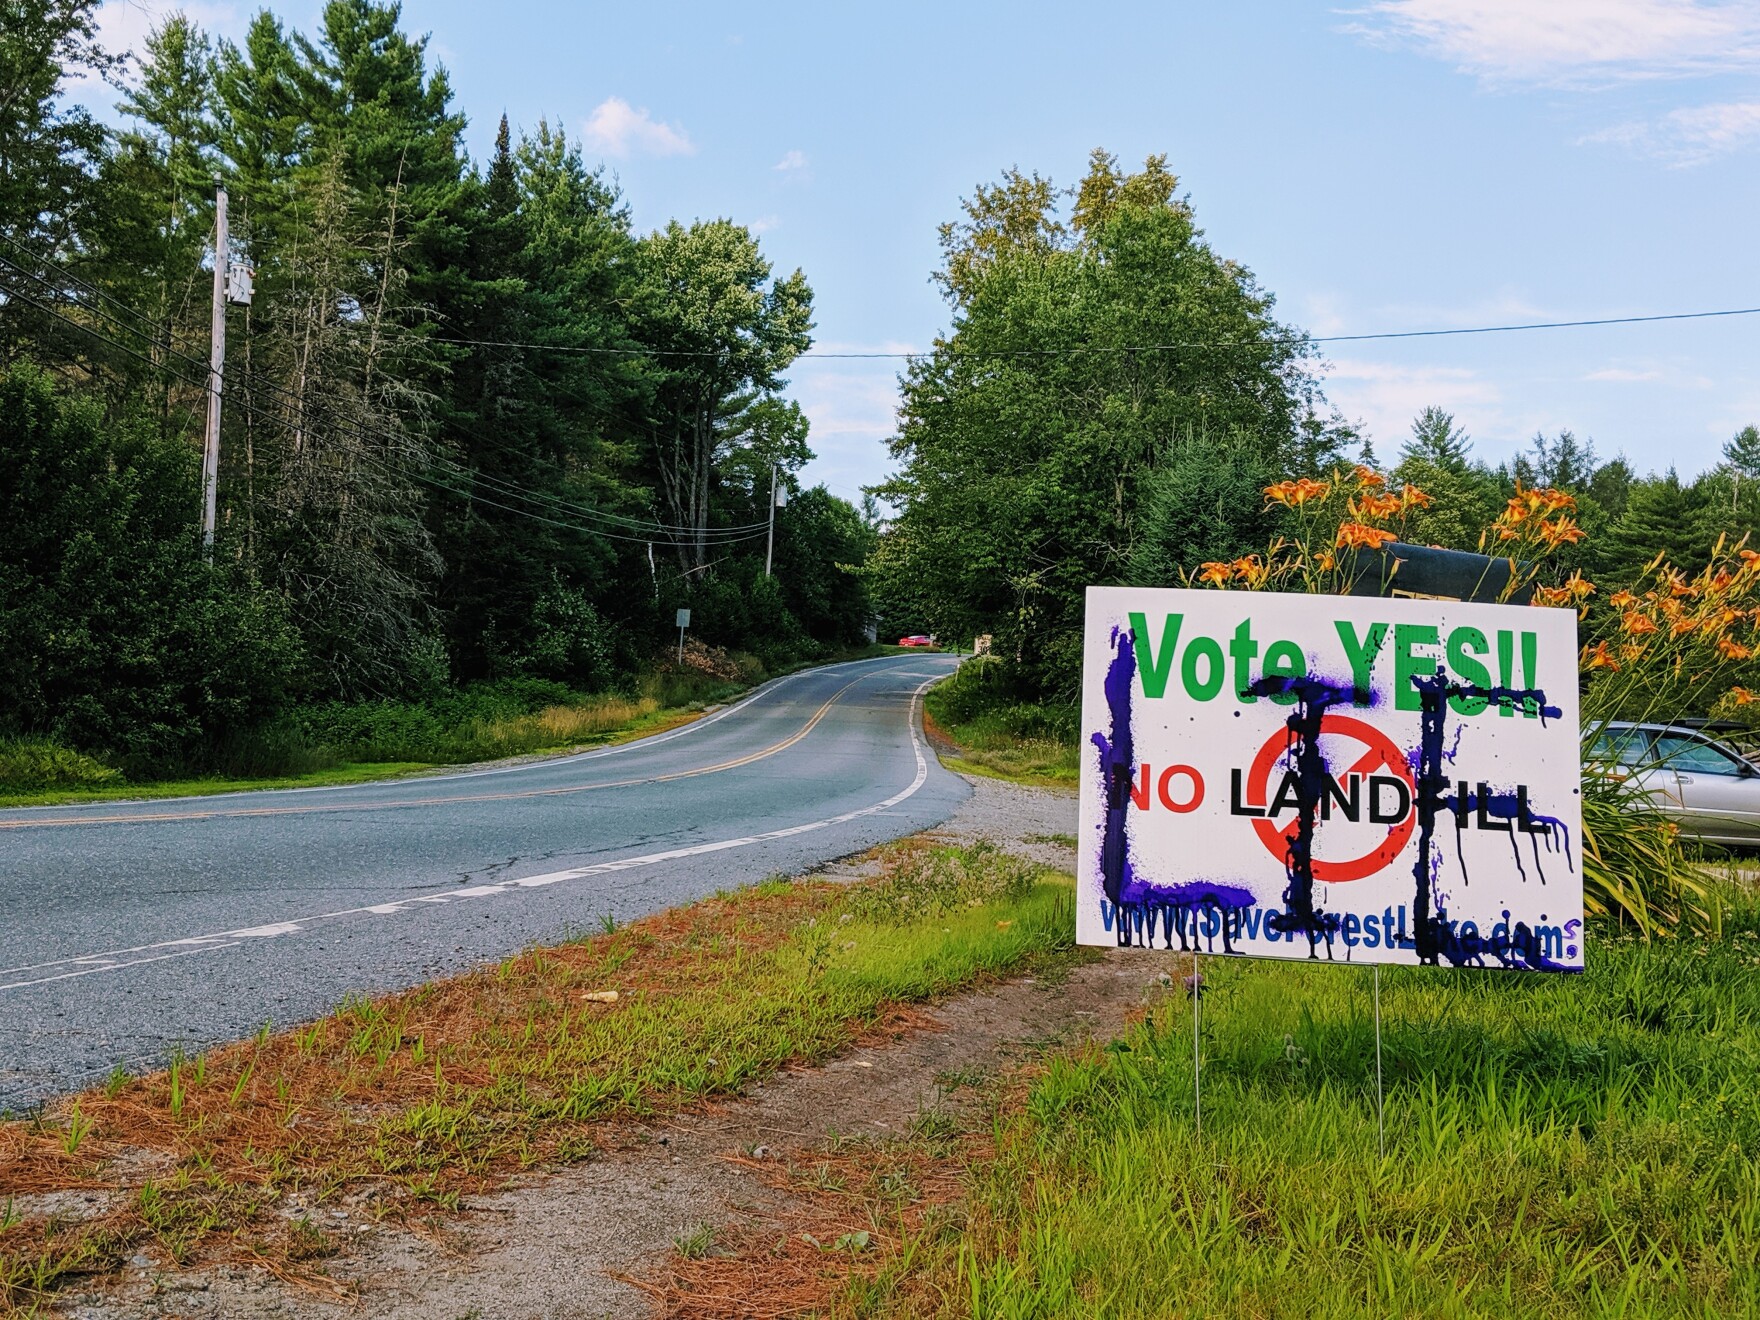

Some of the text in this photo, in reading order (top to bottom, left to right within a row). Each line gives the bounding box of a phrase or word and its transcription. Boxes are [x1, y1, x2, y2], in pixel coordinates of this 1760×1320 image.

[1128, 611, 1538, 719] Vote YES!!
[1111, 762, 1552, 835] NO LANDILL
